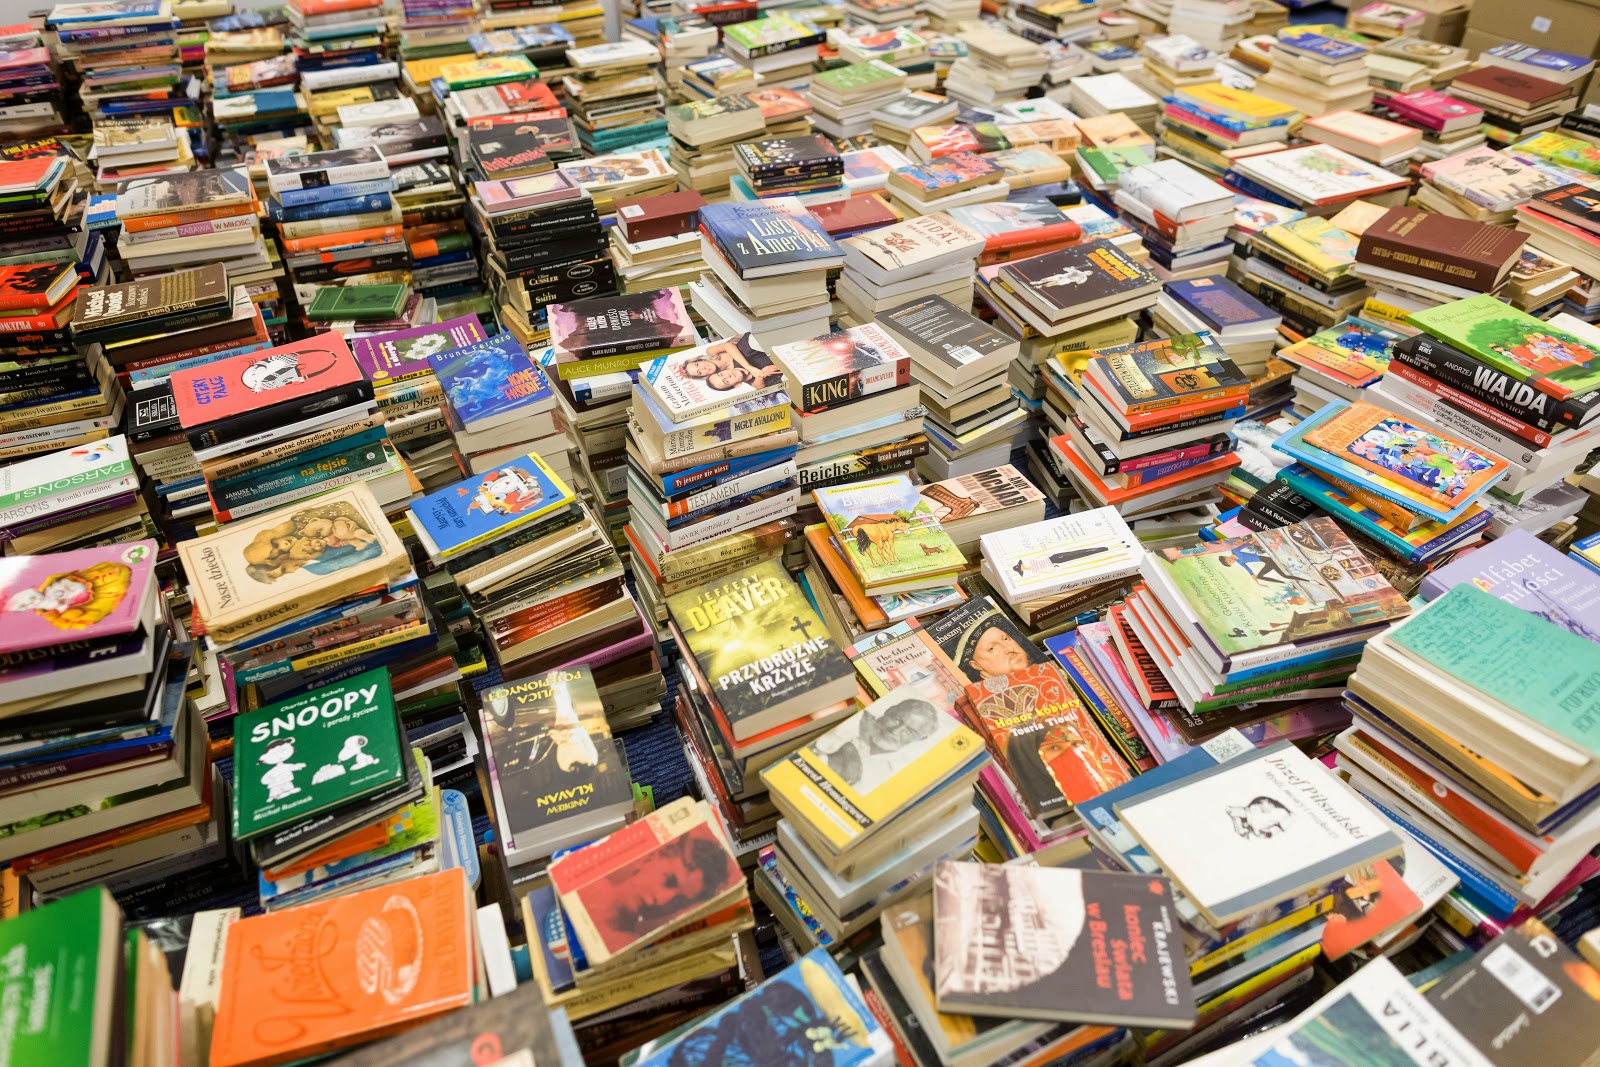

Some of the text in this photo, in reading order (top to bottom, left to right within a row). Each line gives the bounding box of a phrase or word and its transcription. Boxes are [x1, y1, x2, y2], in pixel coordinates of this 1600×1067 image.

[179, 222, 211, 236] ZABAWA
[214, 223, 224, 232] W
[750, 216, 797, 237] Listy
[914, 218, 956, 245] VIDAL
[736, 230, 831, 257] z Ameryki
[1415, 257, 1477, 279] PODRĘCZNY SŁOWNIK
[529, 275, 559, 286] CUSSLER
[535, 294, 557, 304] SMITH
[176, 351, 193, 359] domu
[437, 335, 512, 362] Bruno Ferrero
[49, 365, 68, 373] Carroll
[151, 365, 176, 375] Dziennik
[505, 367, 534, 386] NOWE
[565, 358, 630, 375] ALICE MUNRO
[1444, 361, 1473, 377] ANDRZEJ
[866, 371, 893, 384] DREAMCATCHER
[1401, 368, 1433, 387] PAVEL USOV
[192, 378, 211, 405] CZTERY
[810, 378, 847, 405] KING
[1472, 366, 1549, 416] WAJDA
[11, 404, 62, 418] Transylwania
[384, 404, 410, 416] POEZJE
[1486, 391, 1525, 416] JOHANNES
[1, 418, 41, 432] Dziennik 1954
[734, 411, 786, 431] MGŁY AVALONU
[261, 422, 360, 458] Jak zostać obrzydliwie bogatym
[389, 429, 414, 441] POEZJE
[26, 441, 66, 451] TRUDNY TRUP
[878, 451, 891, 461] break
[898, 448, 912, 457] bones
[216, 458, 258, 477] MOHSIN HAMID
[301, 457, 347, 476] na fejsie
[661, 453, 720, 470] Jude Deveraux
[23, 460, 126, 500] PARSONS
[225, 472, 250, 482] Znaki
[800, 462, 850, 484] Reichs
[56, 483, 112, 504] Kroniki rodzinne
[225, 475, 296, 500] JANUSZ WIŚNIEWSKI
[956, 476, 979, 494] DARK
[689, 483, 740, 509] TESTAMENT
[1259, 506, 1273, 515] J.M.
[201, 546, 232, 609] Nasze dziecko
[1081, 575, 1111, 586] MADAME
[1478, 553, 1542, 591] alfabet
[696, 574, 760, 604] JEFFERY
[1203, 575, 1233, 617] Gelsomino
[686, 577, 790, 633] DEAVER
[1036, 604, 1060, 620] JOANNA
[217, 601, 299, 637] Nasze dziecko
[934, 609, 969, 632] George Bidwell
[965, 615, 978, 626] król
[977, 607, 989, 619] Hal
[718, 635, 829, 691] PRZYDROŻNE
[876, 643, 916, 663] The Ghost
[896, 650, 928, 667] McClure
[749, 657, 816, 696] KRZYŻE
[280, 699, 309, 713] Charles
[321, 687, 345, 699] Schulz
[1072, 654, 1132, 729] Na ścieżkach baśni
[250, 684, 378, 743] SNOOPY
[327, 705, 379, 727] porady życiowe
[994, 699, 1082, 729] Honor kobiety
[1010, 723, 1045, 737] Touria
[536, 782, 594, 808] KLAVAN
[546, 796, 590, 816] ANDREW
[1123, 904, 1147, 964] koniec
[1087, 920, 1111, 989] Breslau
[1151, 921, 1179, 1005] KRAJEWSKI
